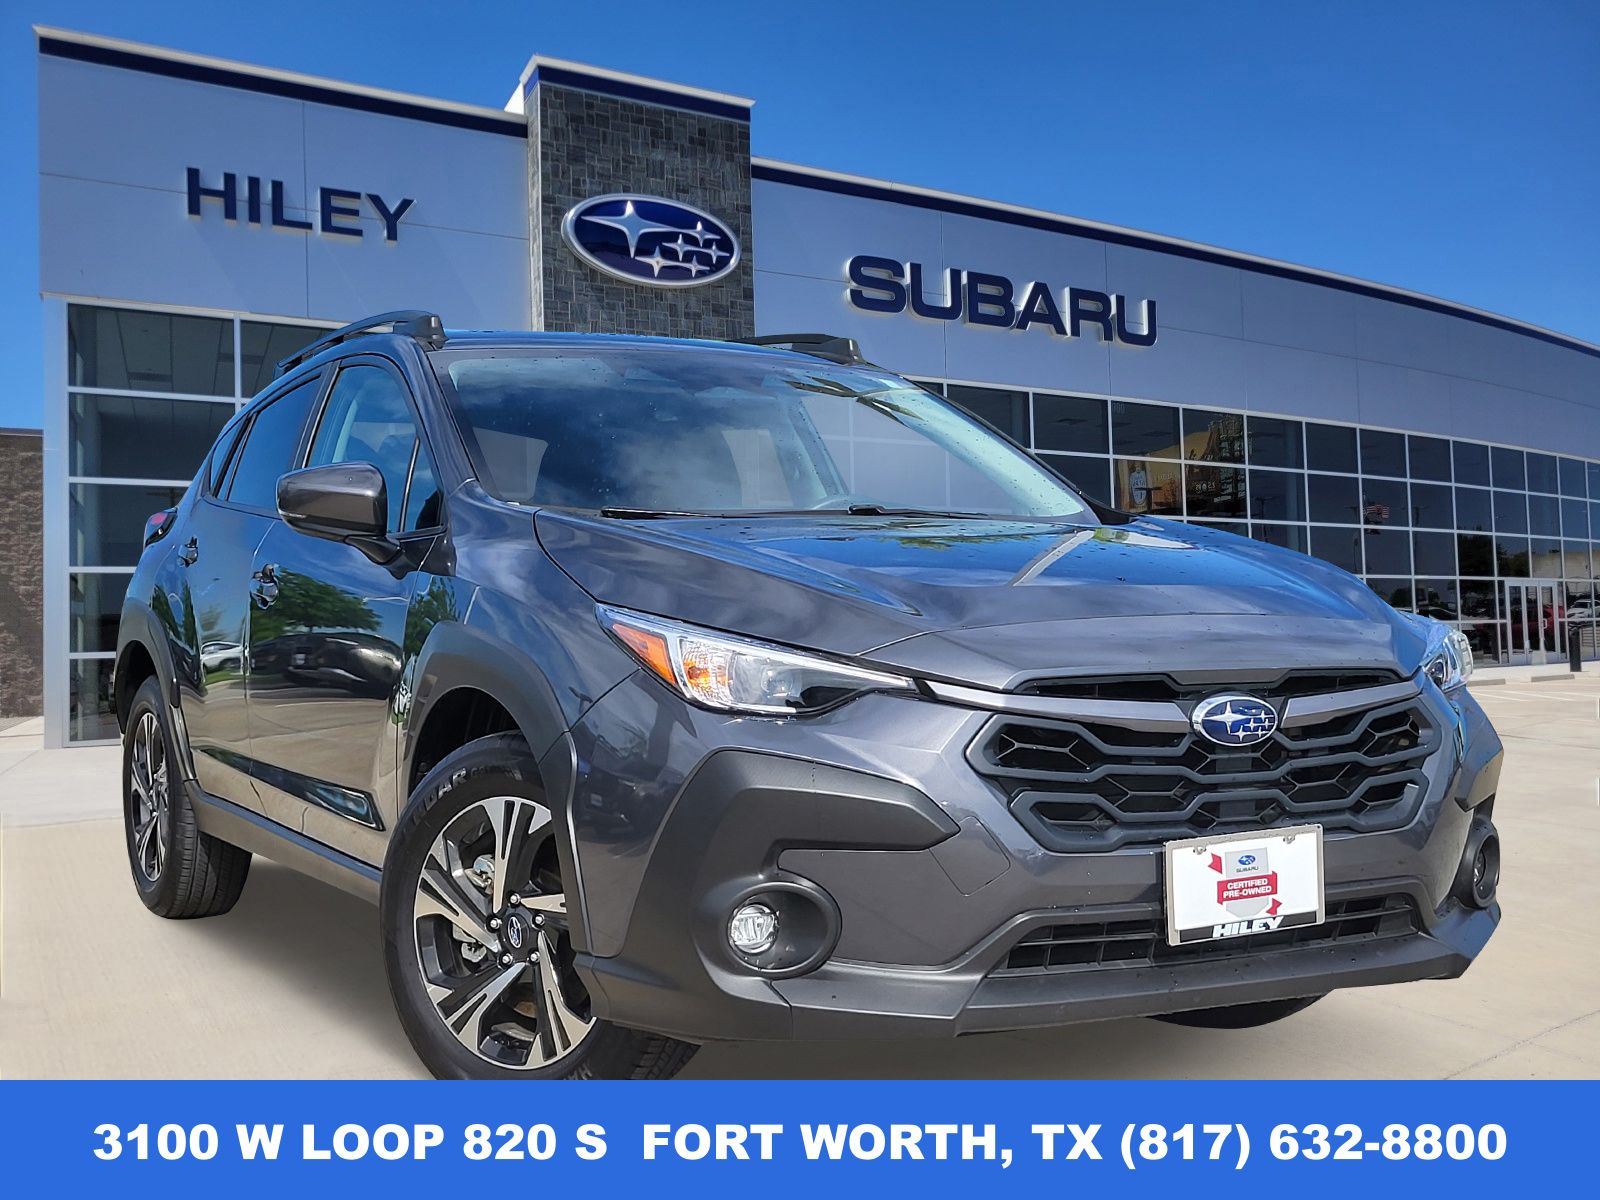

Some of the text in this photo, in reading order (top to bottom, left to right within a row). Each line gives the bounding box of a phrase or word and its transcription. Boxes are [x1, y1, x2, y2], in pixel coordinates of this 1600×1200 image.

[187, 166, 416, 241] HILEY
[845, 255, 1158, 347] SUBARU
[1223, 885, 1272, 899] PRE-OWNED
[1227, 878, 1269, 890] CERTIFIED
[1212, 916, 1284, 938] HILEY
